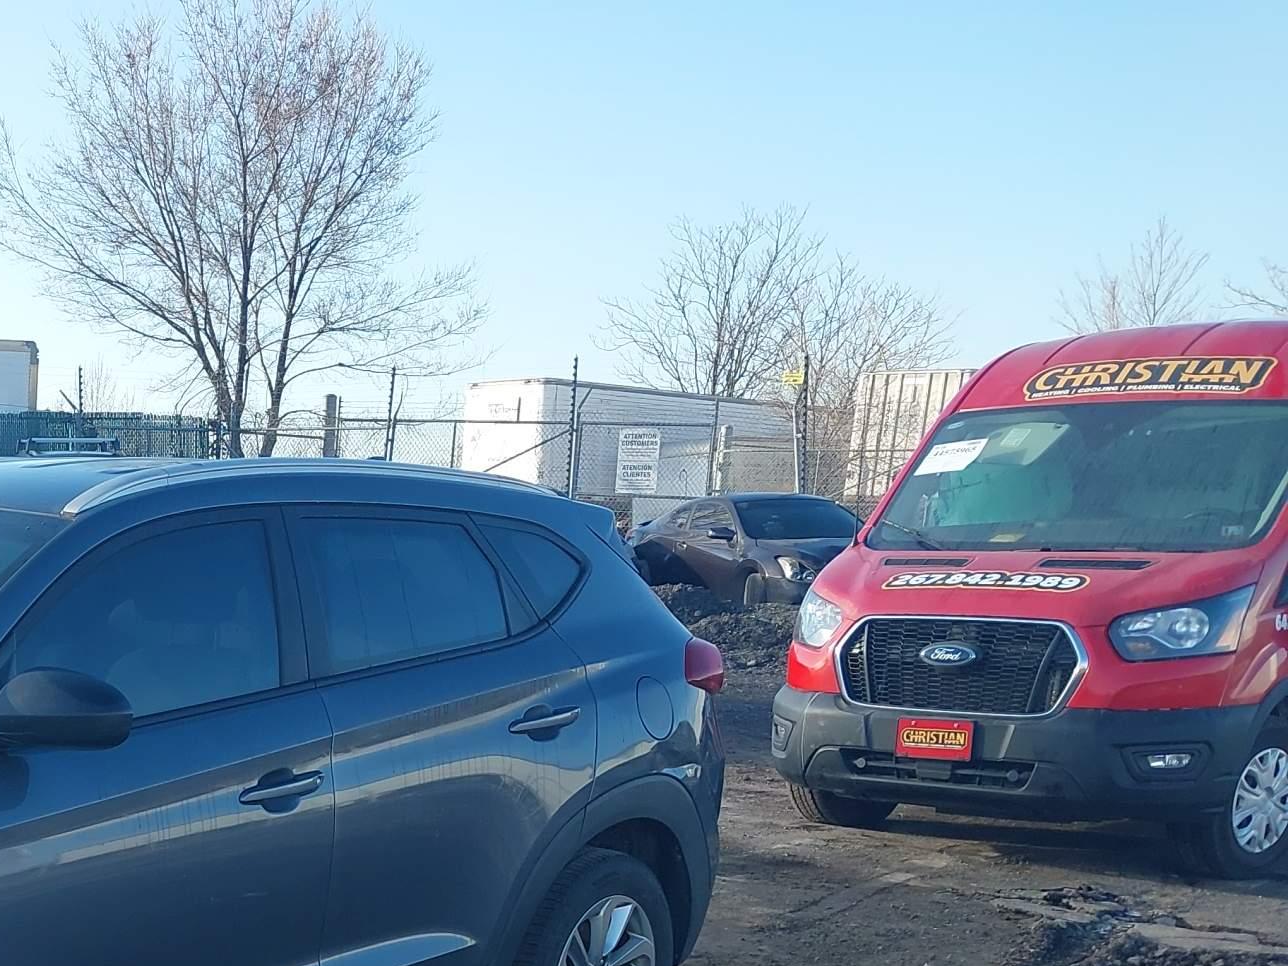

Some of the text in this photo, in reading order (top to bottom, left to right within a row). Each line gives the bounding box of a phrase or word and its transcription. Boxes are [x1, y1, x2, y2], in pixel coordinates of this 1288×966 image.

[1034, 359, 1265, 390] CHRISTIAN
[1031, 389, 1070, 398] HEATING
[1077, 385, 1119, 393] COOLING
[891, 573, 1081, 589] 267.842.1989
[930, 647, 962, 660] Ford
[903, 729, 965, 745] CHRISTIAN
